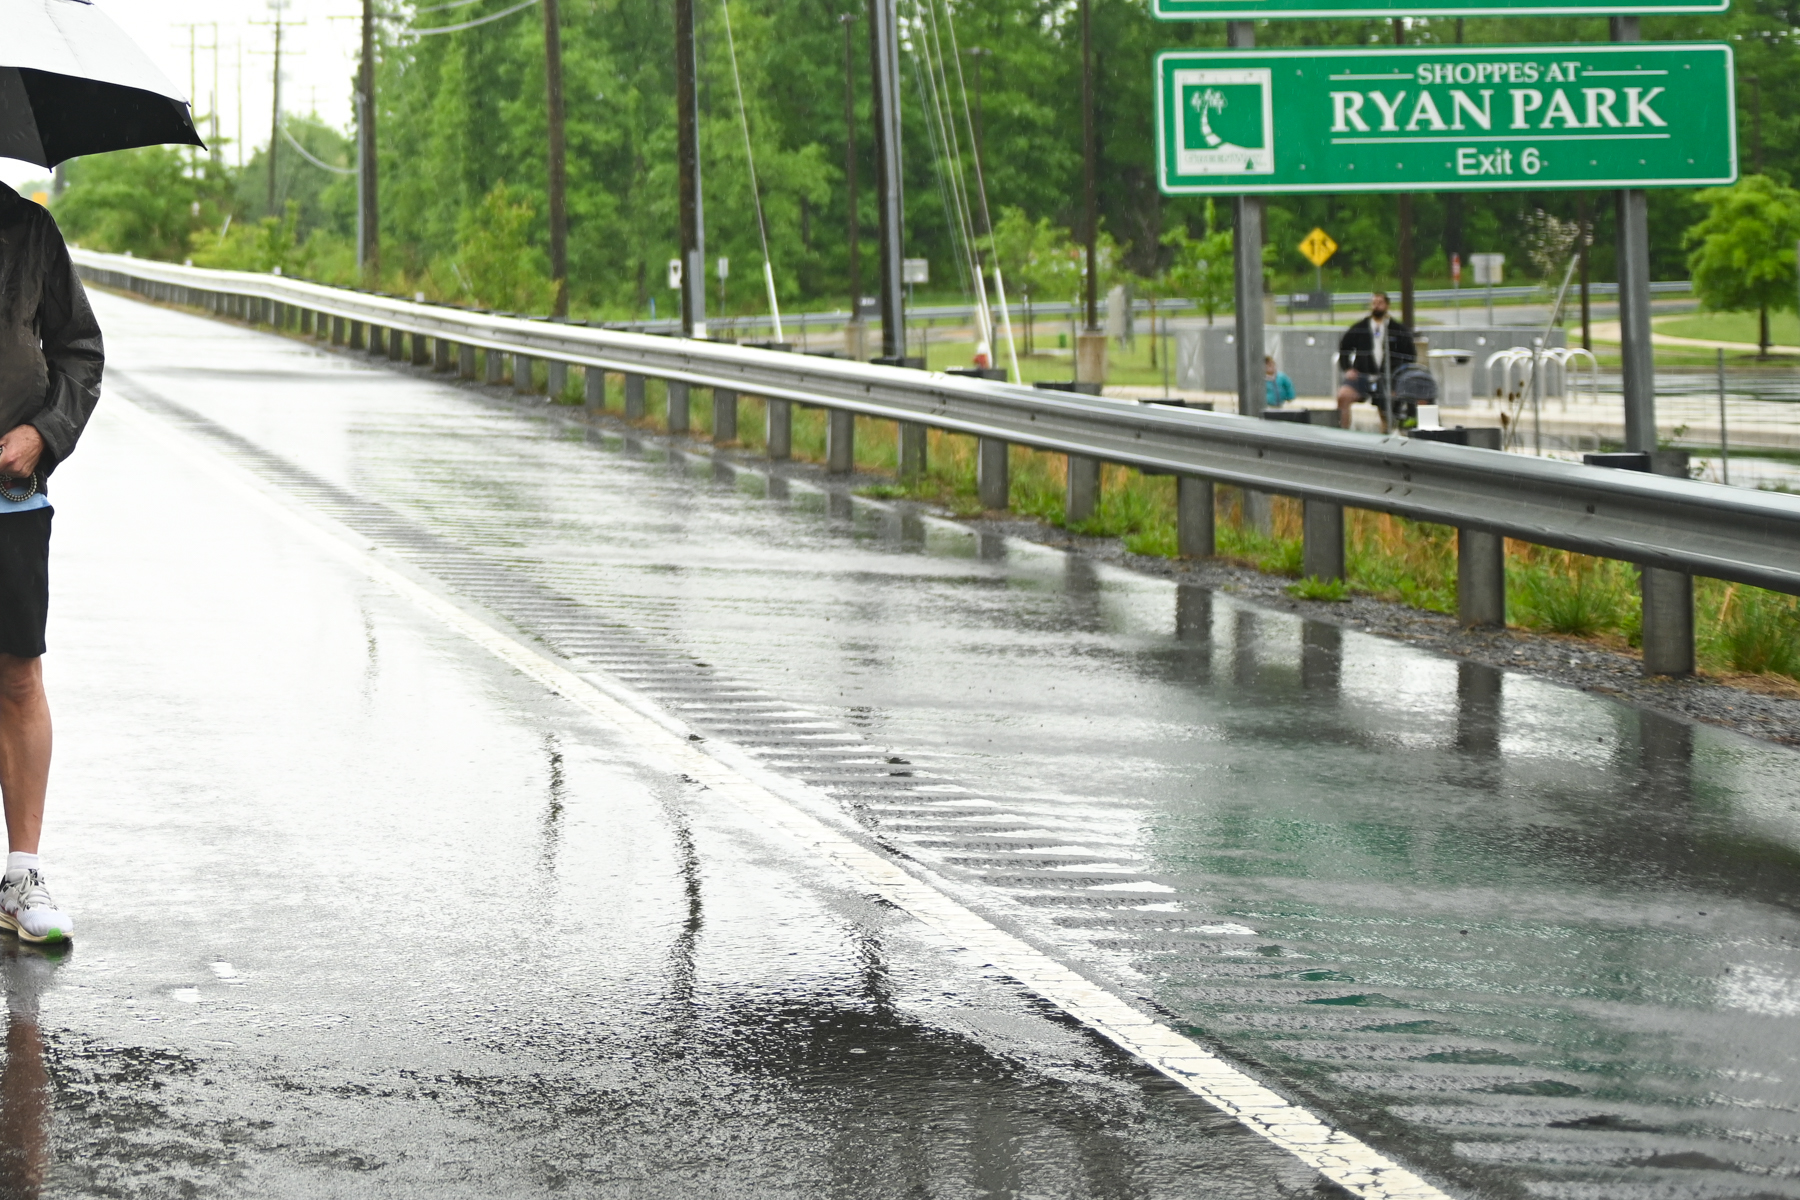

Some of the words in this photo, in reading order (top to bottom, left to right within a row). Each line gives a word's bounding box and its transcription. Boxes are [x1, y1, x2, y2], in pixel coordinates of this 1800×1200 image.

[1417, 62, 1539, 85] SHOPPES
[1545, 61, 1580, 82] AT
[1330, 89, 1494, 132] RYAN
[1509, 86, 1668, 130] PARK
[1456, 148, 1513, 176] Exit
[1521, 147, 1541, 175] 6
